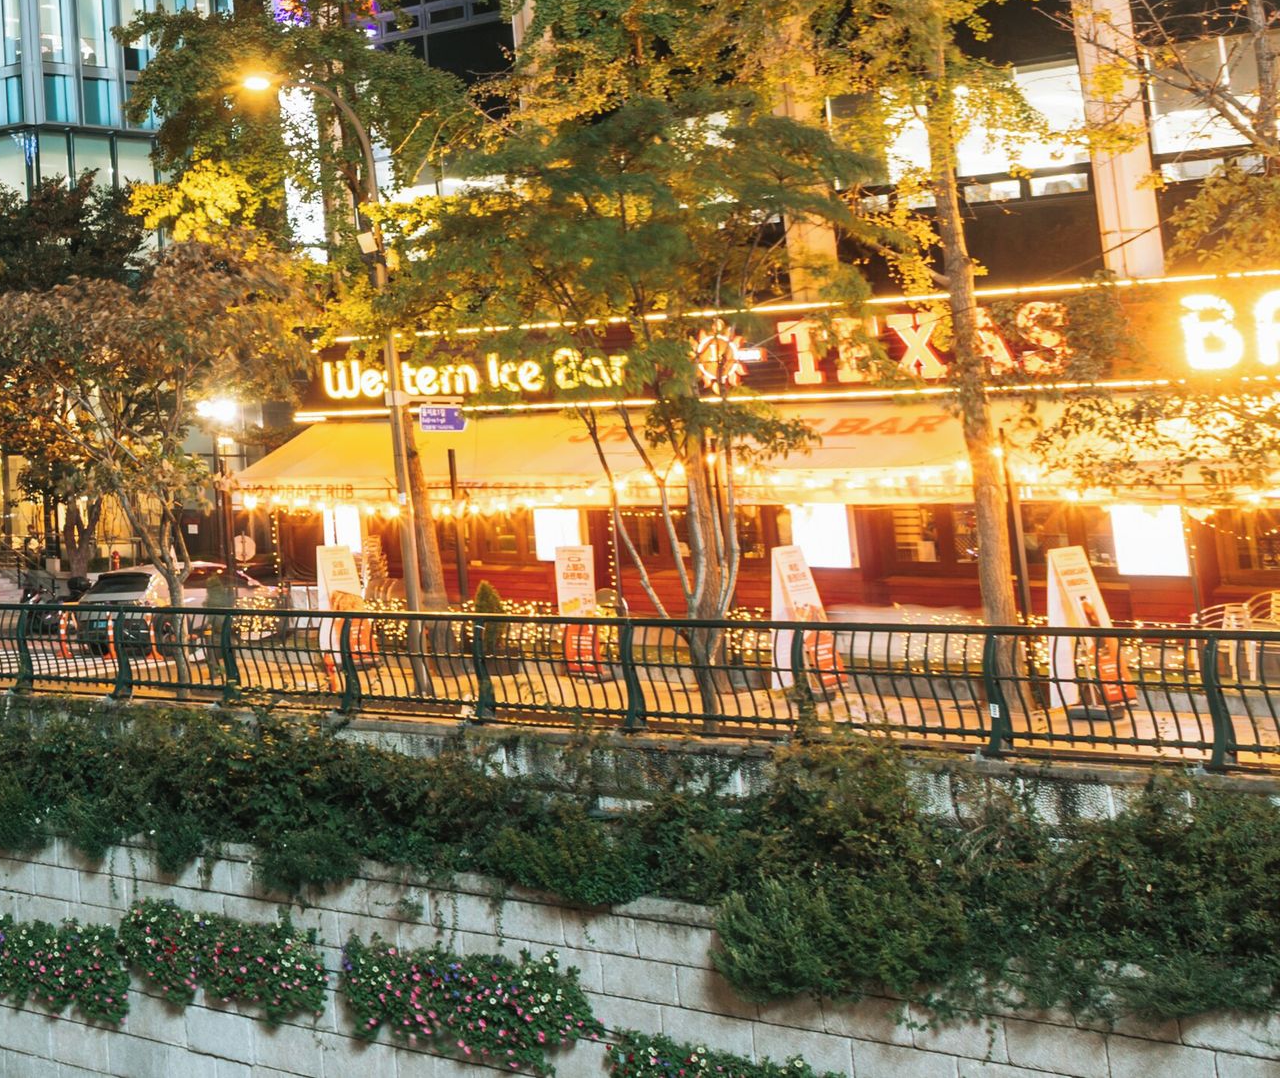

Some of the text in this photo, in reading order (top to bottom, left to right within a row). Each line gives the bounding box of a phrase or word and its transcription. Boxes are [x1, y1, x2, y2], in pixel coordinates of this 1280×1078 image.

[322, 347, 629, 399] Wetern Ice Bar
